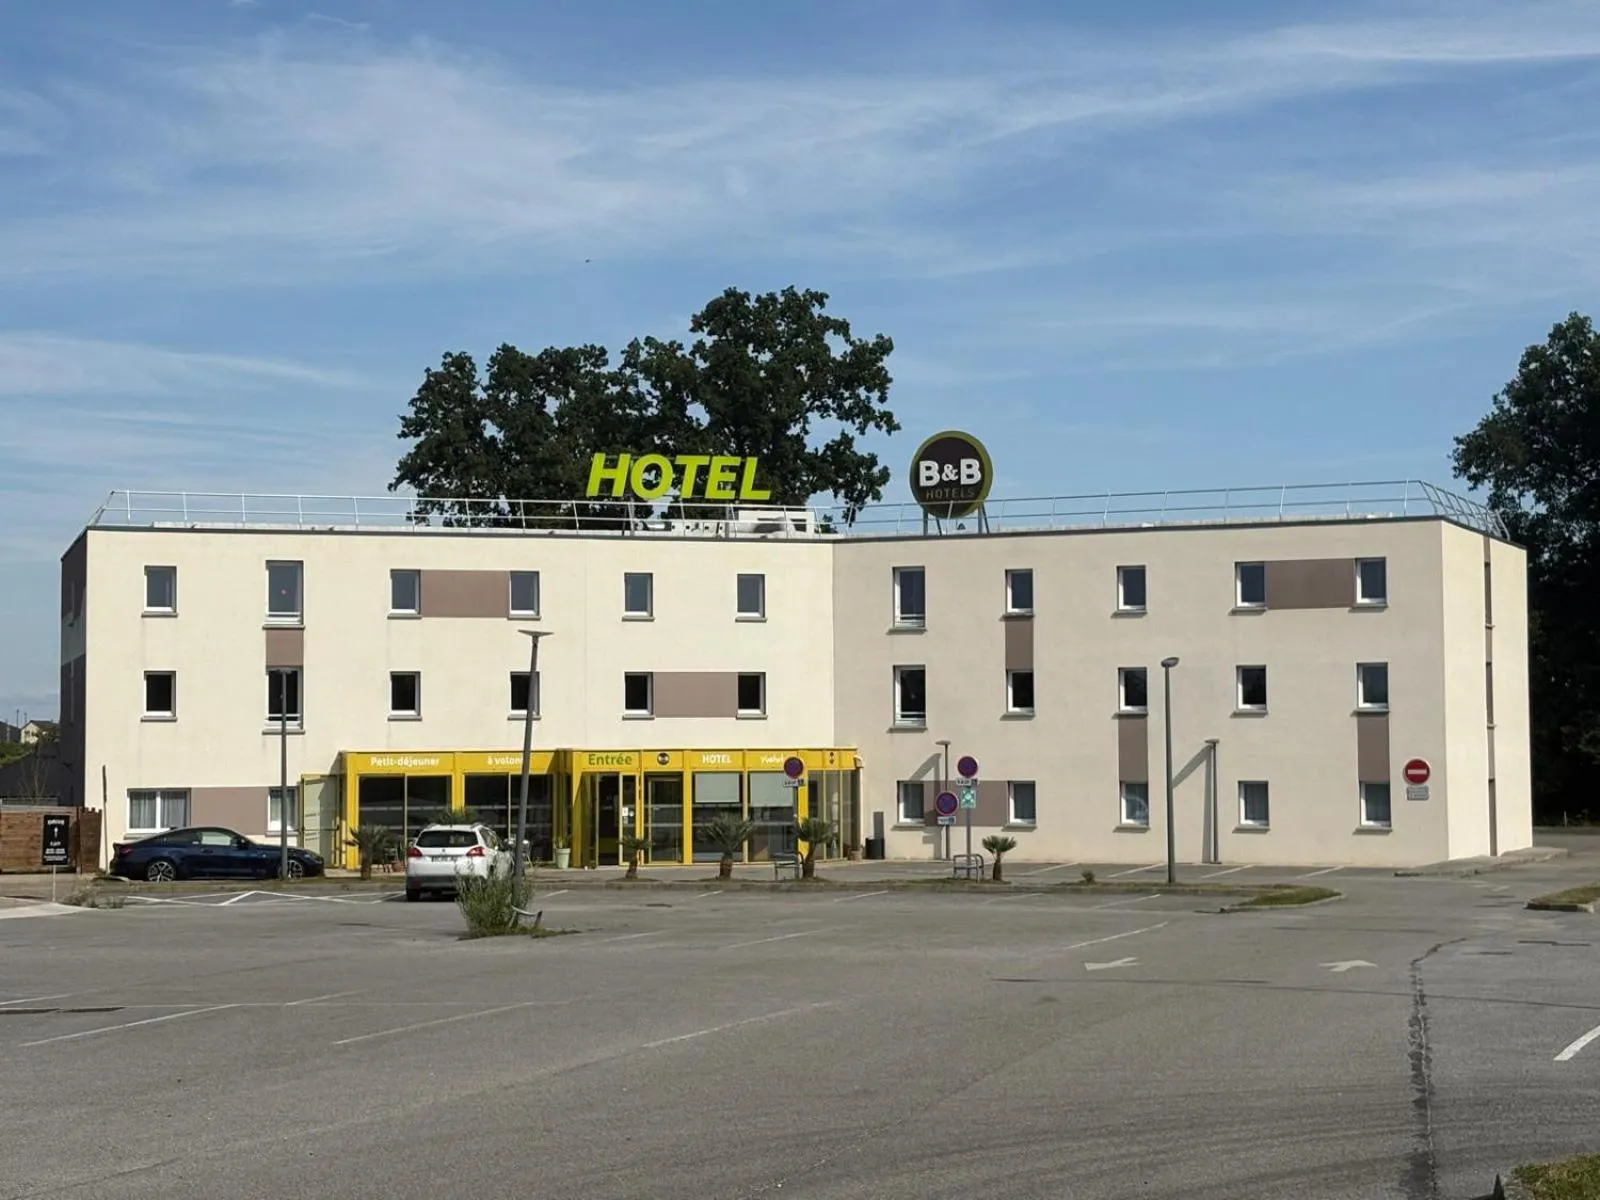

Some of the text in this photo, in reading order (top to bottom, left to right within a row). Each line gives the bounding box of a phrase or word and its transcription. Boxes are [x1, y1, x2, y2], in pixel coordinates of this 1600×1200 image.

[586, 452, 772, 501] HOTEL
[918, 457, 983, 487] B&B
[925, 487, 974, 500] HOTELS
[370, 755, 441, 768] Petit-déjeuner
[588, 753, 633, 766] Entrée
[701, 754, 733, 765] HOTEL
